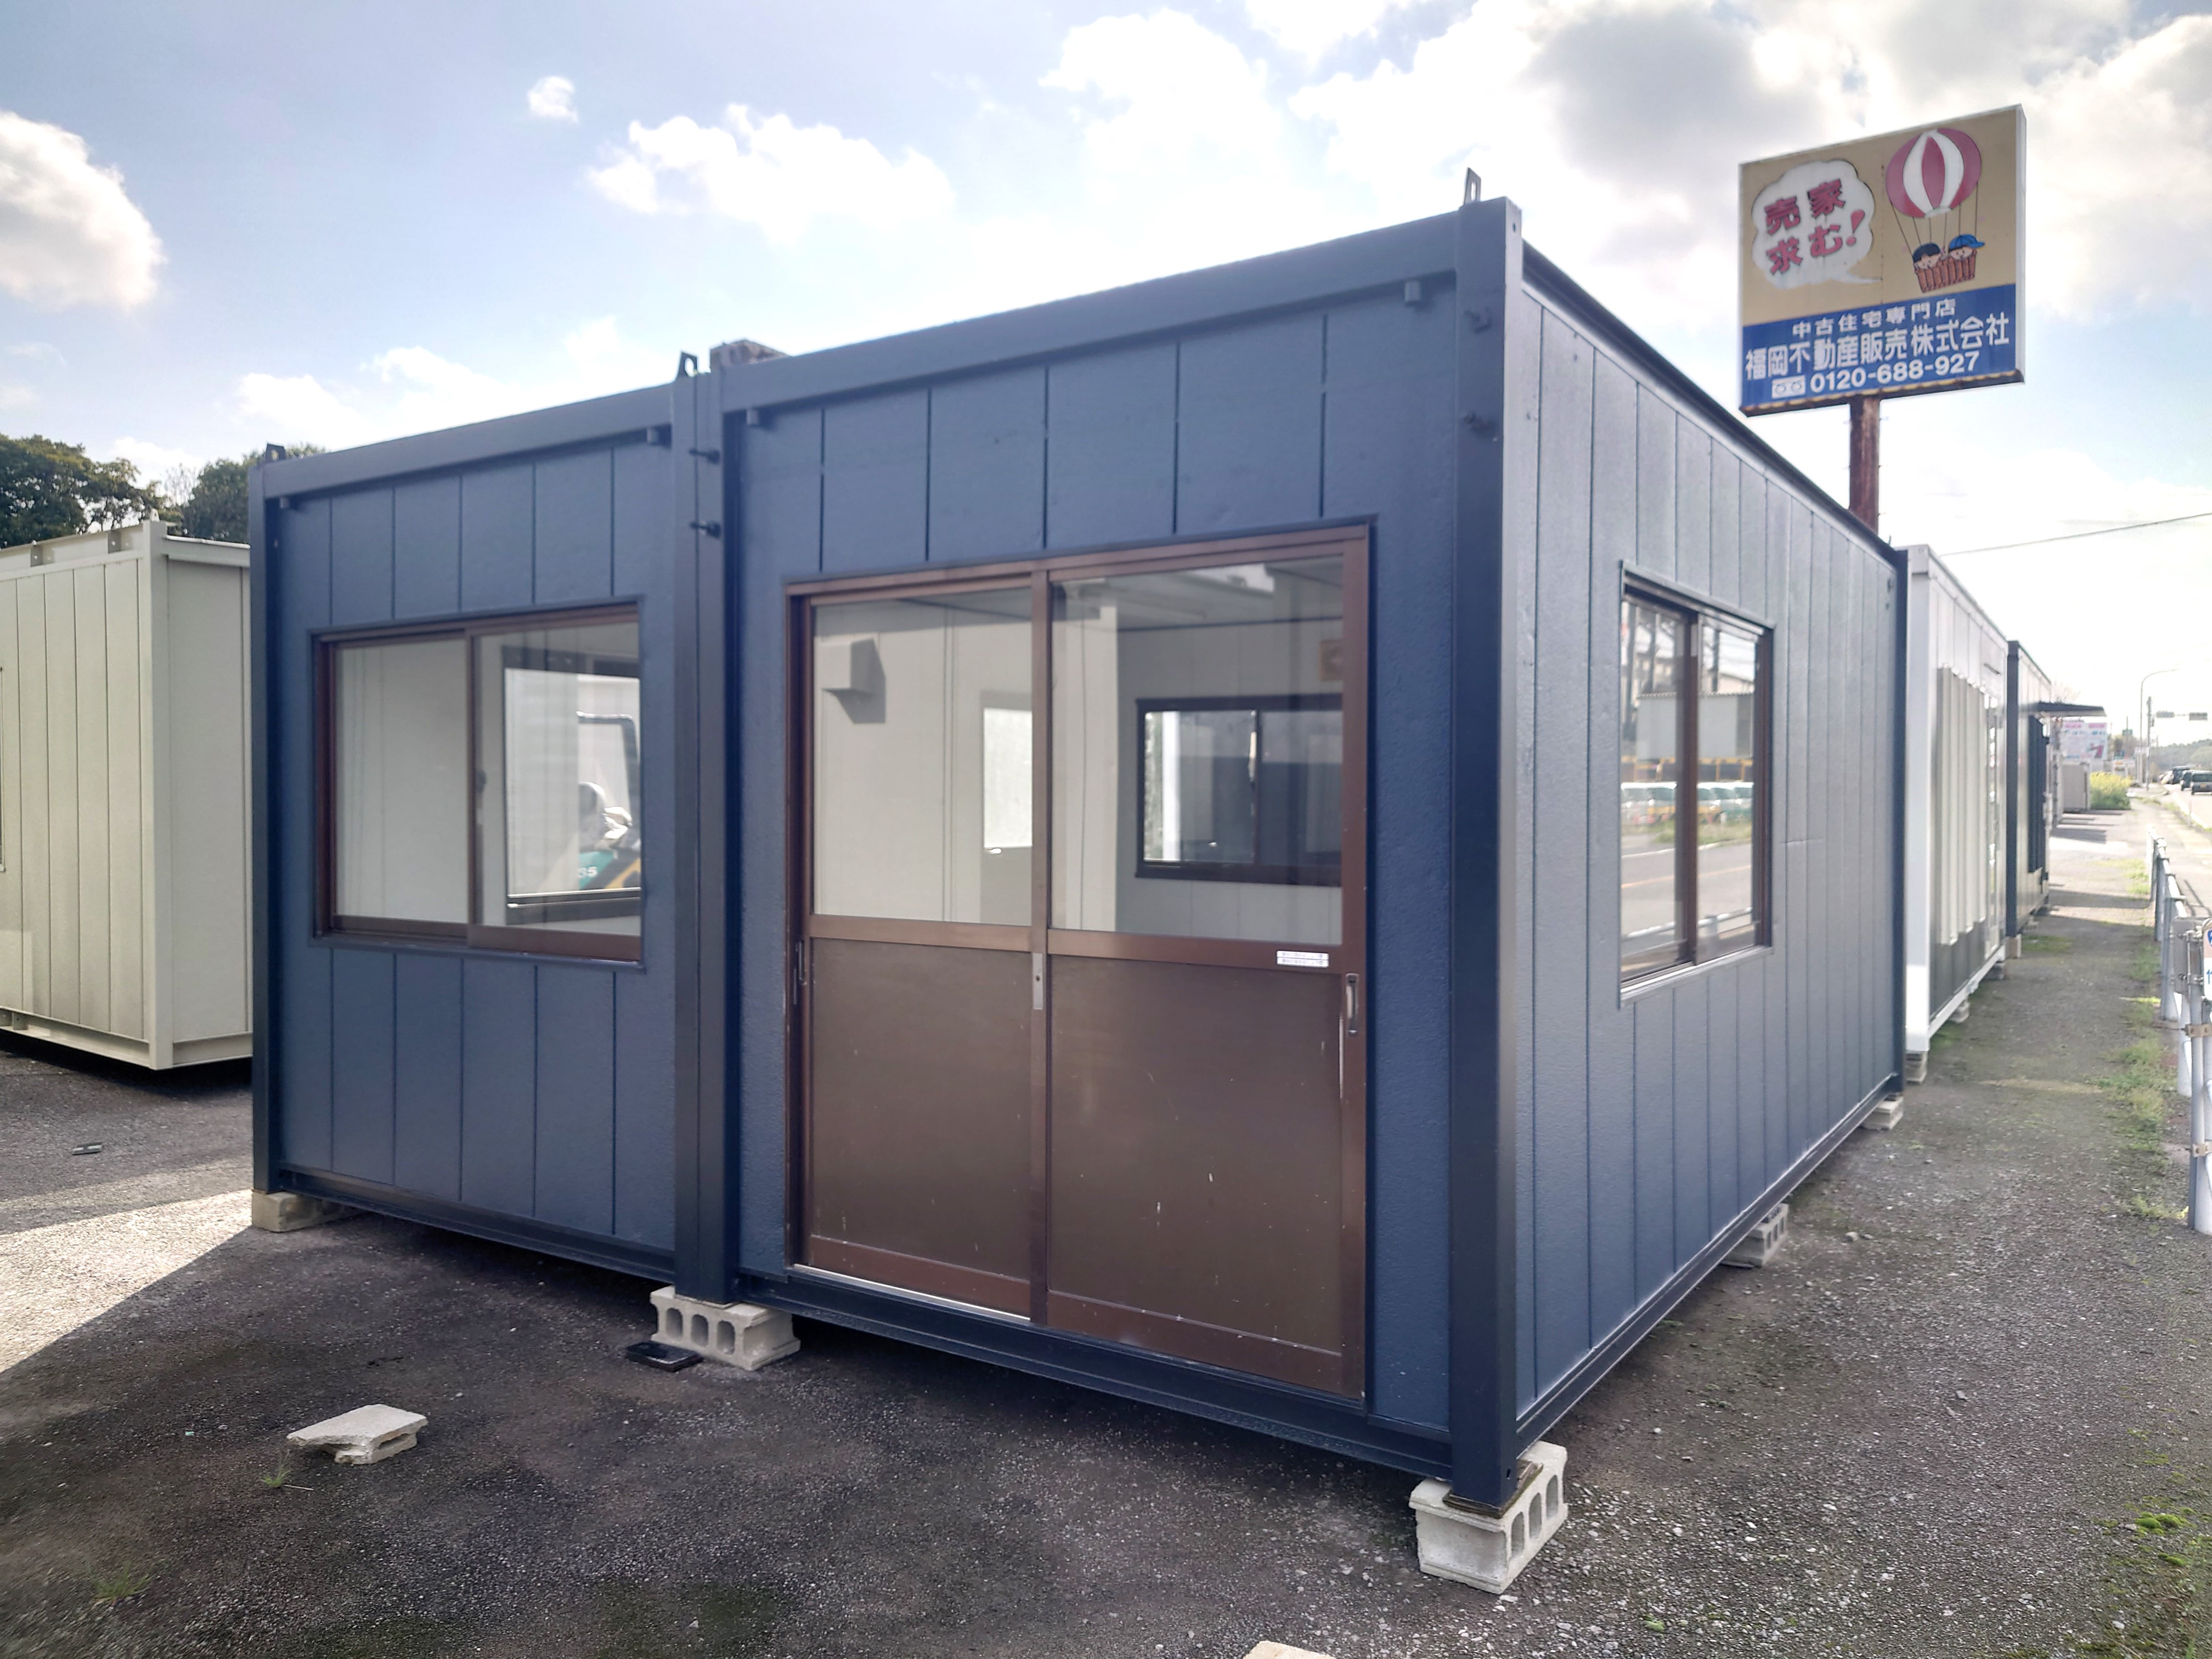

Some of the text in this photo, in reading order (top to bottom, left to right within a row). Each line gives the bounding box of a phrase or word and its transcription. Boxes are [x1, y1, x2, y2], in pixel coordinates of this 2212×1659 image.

[1764, 179, 1846, 235] 売家
[1746, 312, 2010, 380] 福岡不動産販売株式会社
[1810, 351, 1979, 393] 0120-688-927
